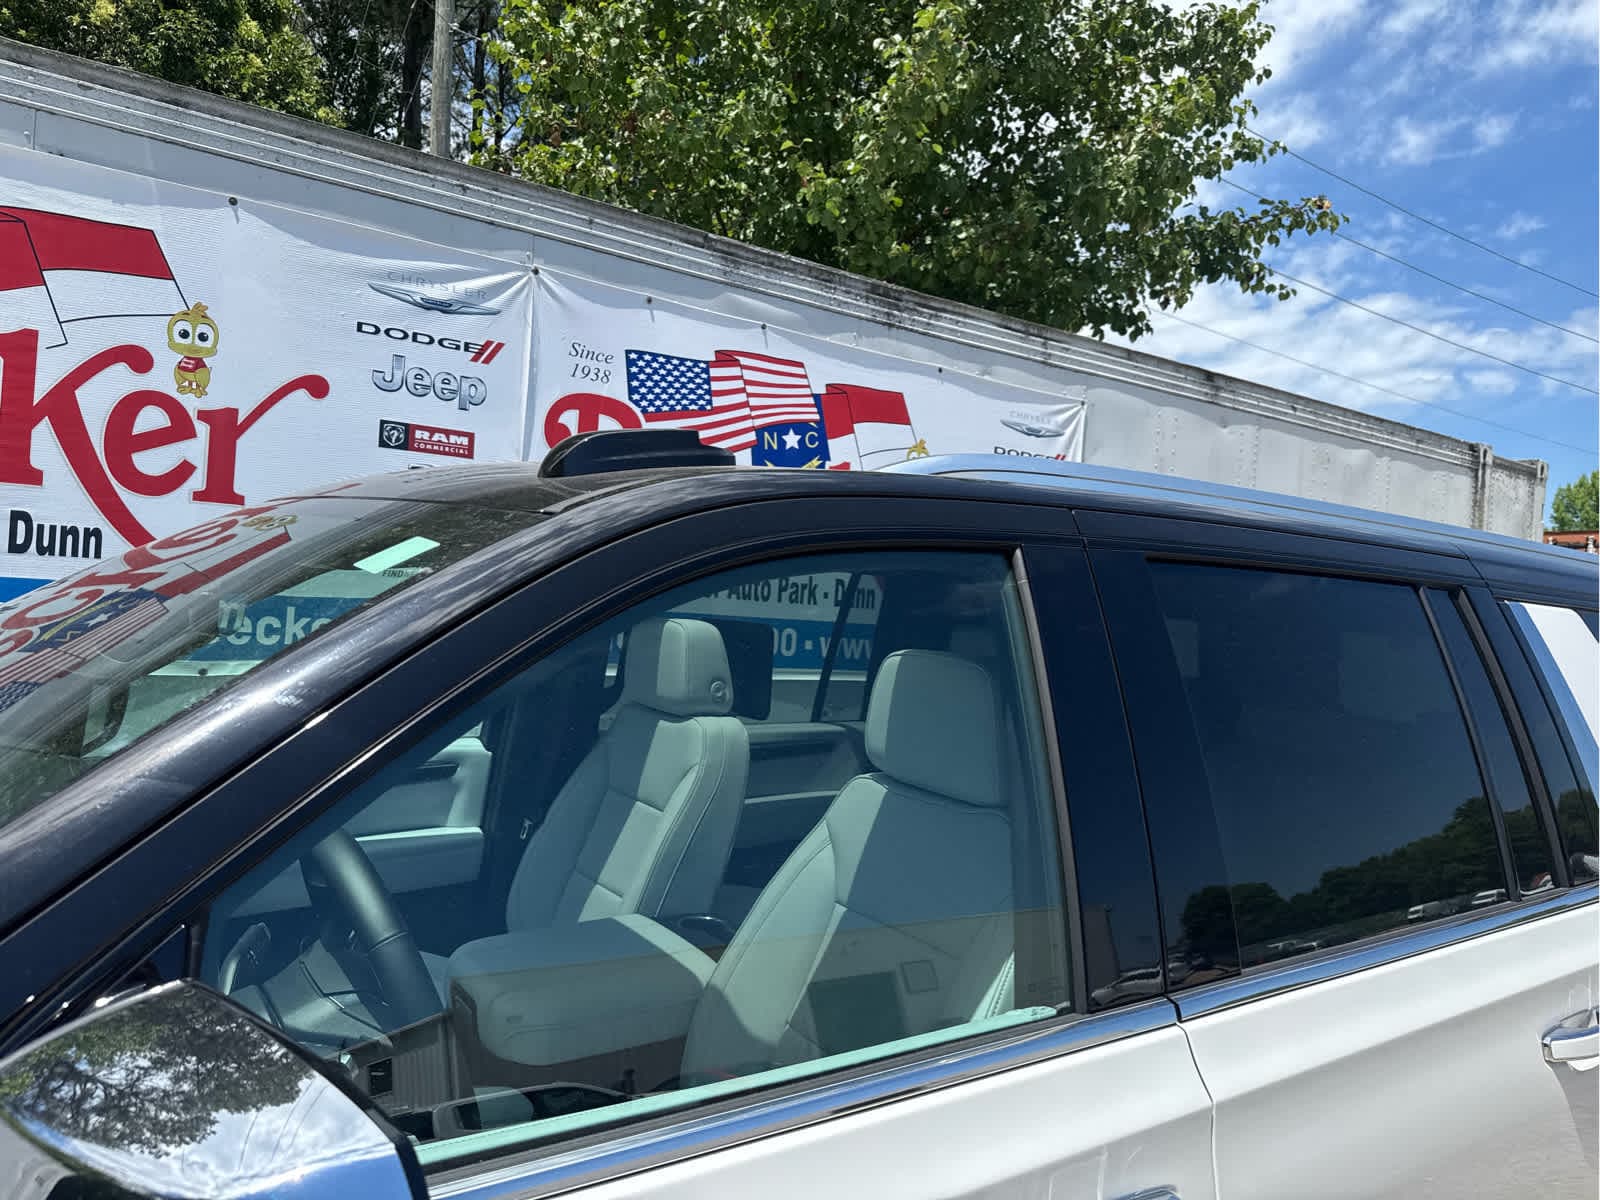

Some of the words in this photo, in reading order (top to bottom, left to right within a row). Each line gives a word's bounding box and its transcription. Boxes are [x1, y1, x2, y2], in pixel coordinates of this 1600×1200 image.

[356, 321, 486, 355] DODGE
[569, 341, 614, 364] Since
[371, 353, 488, 411] Jeep
[570, 363, 612, 384] 1938
[413, 441, 469, 455] COMMERCIAL
[414, 428, 469, 446] RAM
[763, 431, 778, 451] N
[804, 431, 820, 449] C
[7, 509, 104, 560] Dunn
[776, 575, 818, 606] Park
[834, 578, 876, 609] Dnn
